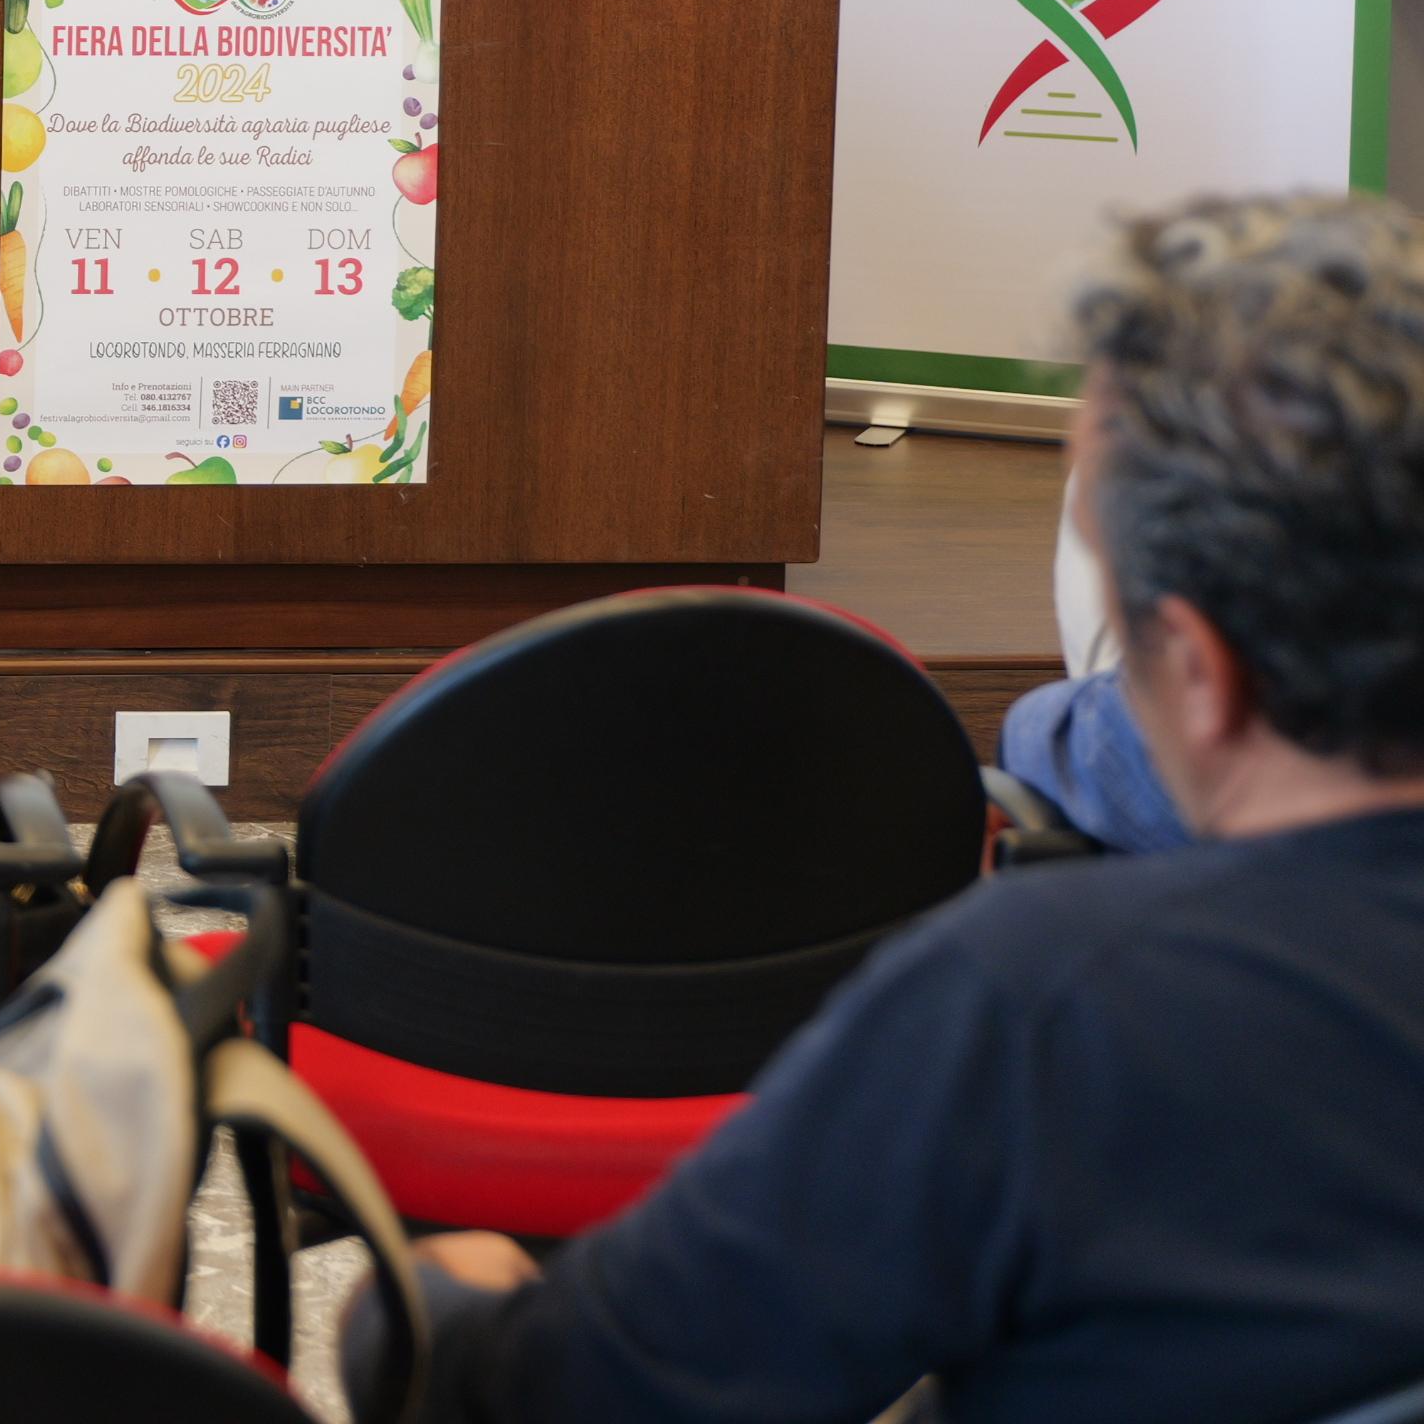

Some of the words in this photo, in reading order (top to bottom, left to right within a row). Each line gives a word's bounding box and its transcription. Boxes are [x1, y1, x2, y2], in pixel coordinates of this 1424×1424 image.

[53, 26, 123, 56] FIERA
[132, 26, 208, 56] DELLA
[218, 26, 391, 57] BIODIVERSITA'
[173, 63, 271, 103] 2024
[45, 113, 98, 135] Dove
[102, 114, 121, 132] la
[125, 113, 238, 133] Biodiversità
[242, 118, 310, 140] agraria
[313, 114, 392, 142] pugliese
[123, 146, 194, 172] affonda
[198, 146, 215, 165] le
[219, 152, 249, 165] sue
[257, 146, 313, 167] Radici
[65, 228, 122, 249] VEN
[190, 229, 243, 249] SAB
[308, 229, 371, 249] DOM
[71, 258, 114, 294] 11
[192, 258, 240, 295] 12
[315, 258, 363, 295] 13
[159, 308, 273, 326] OTTOBRE
[193, 342, 254, 358] MASSERIA
[259, 342, 341, 358] FERRAGNANO
